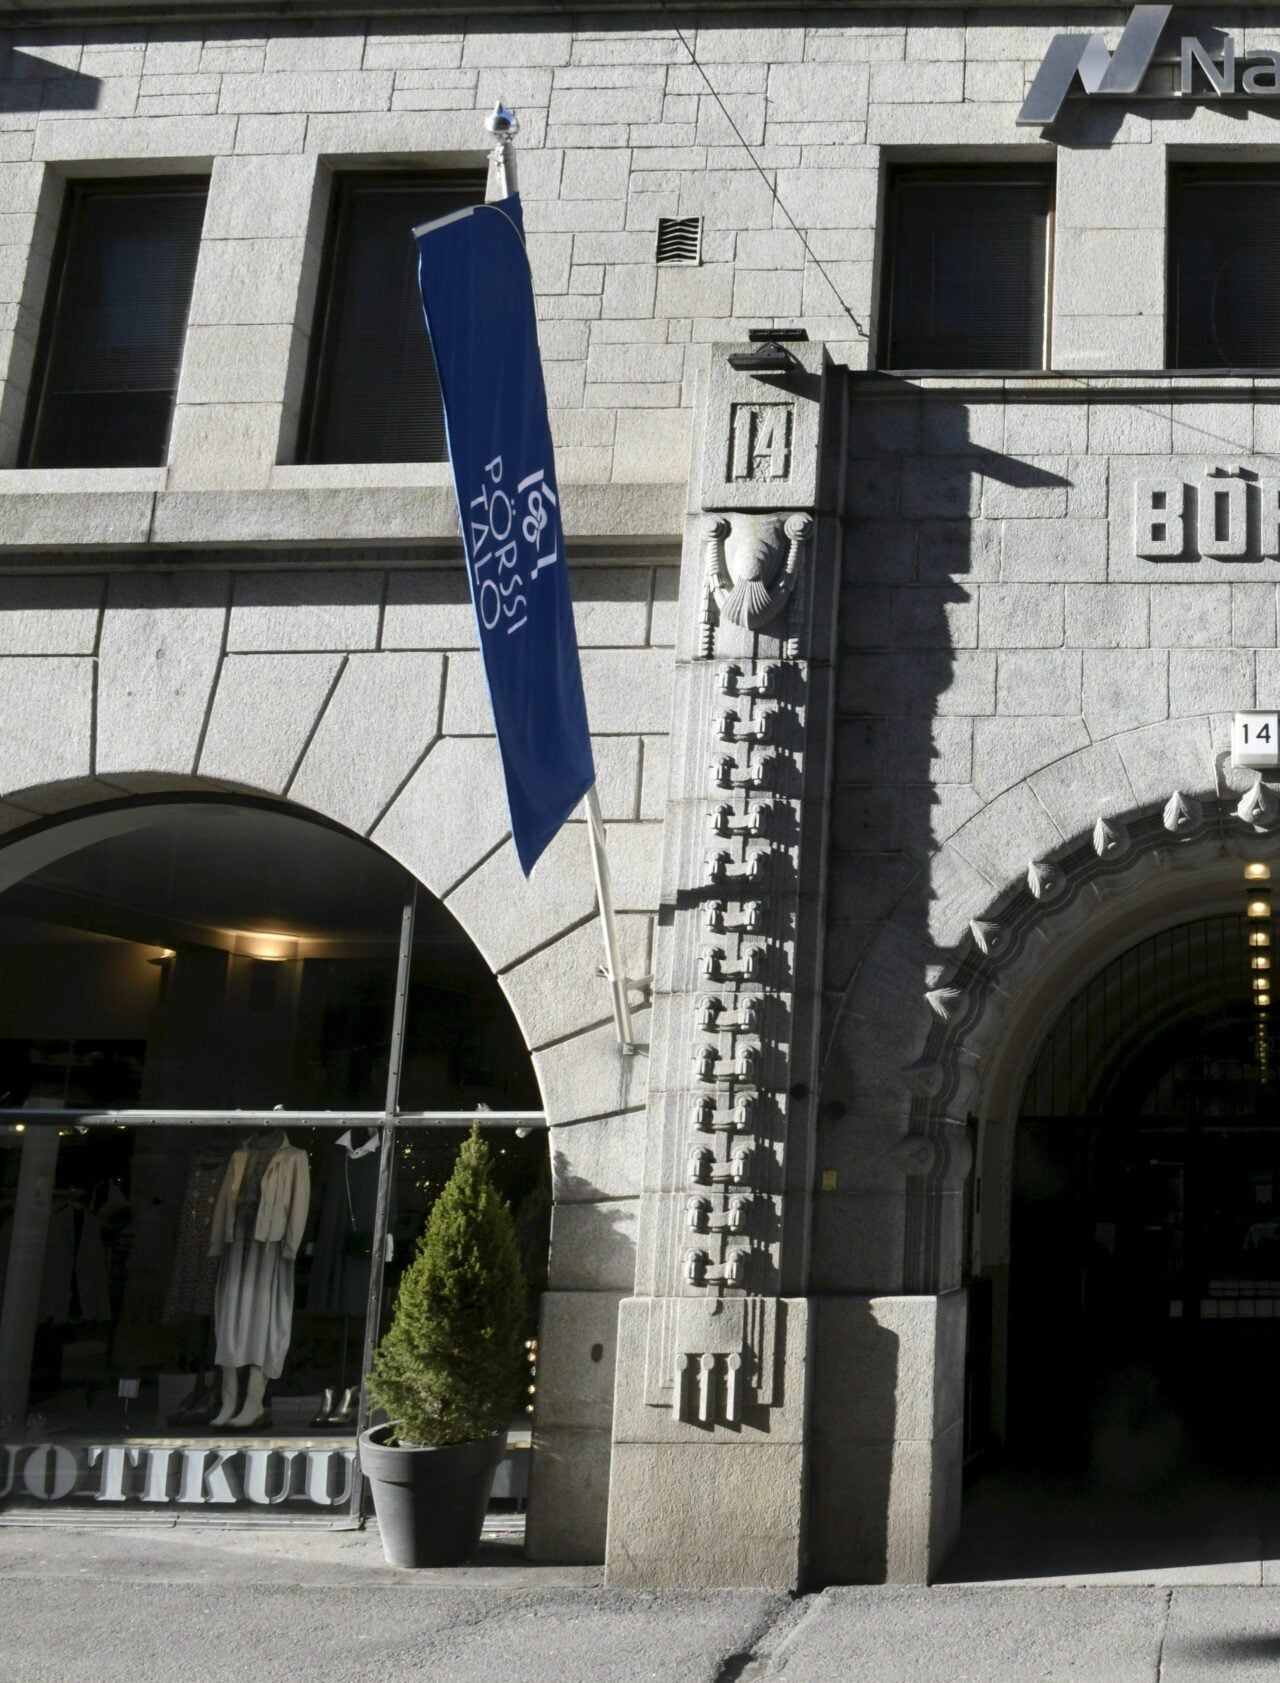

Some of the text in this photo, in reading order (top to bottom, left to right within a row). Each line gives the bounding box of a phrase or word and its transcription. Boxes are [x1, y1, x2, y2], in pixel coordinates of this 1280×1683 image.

[732, 404, 790, 479] 14
[485, 455, 528, 635] PÖRSSI
[1243, 723, 1271, 744] 14
